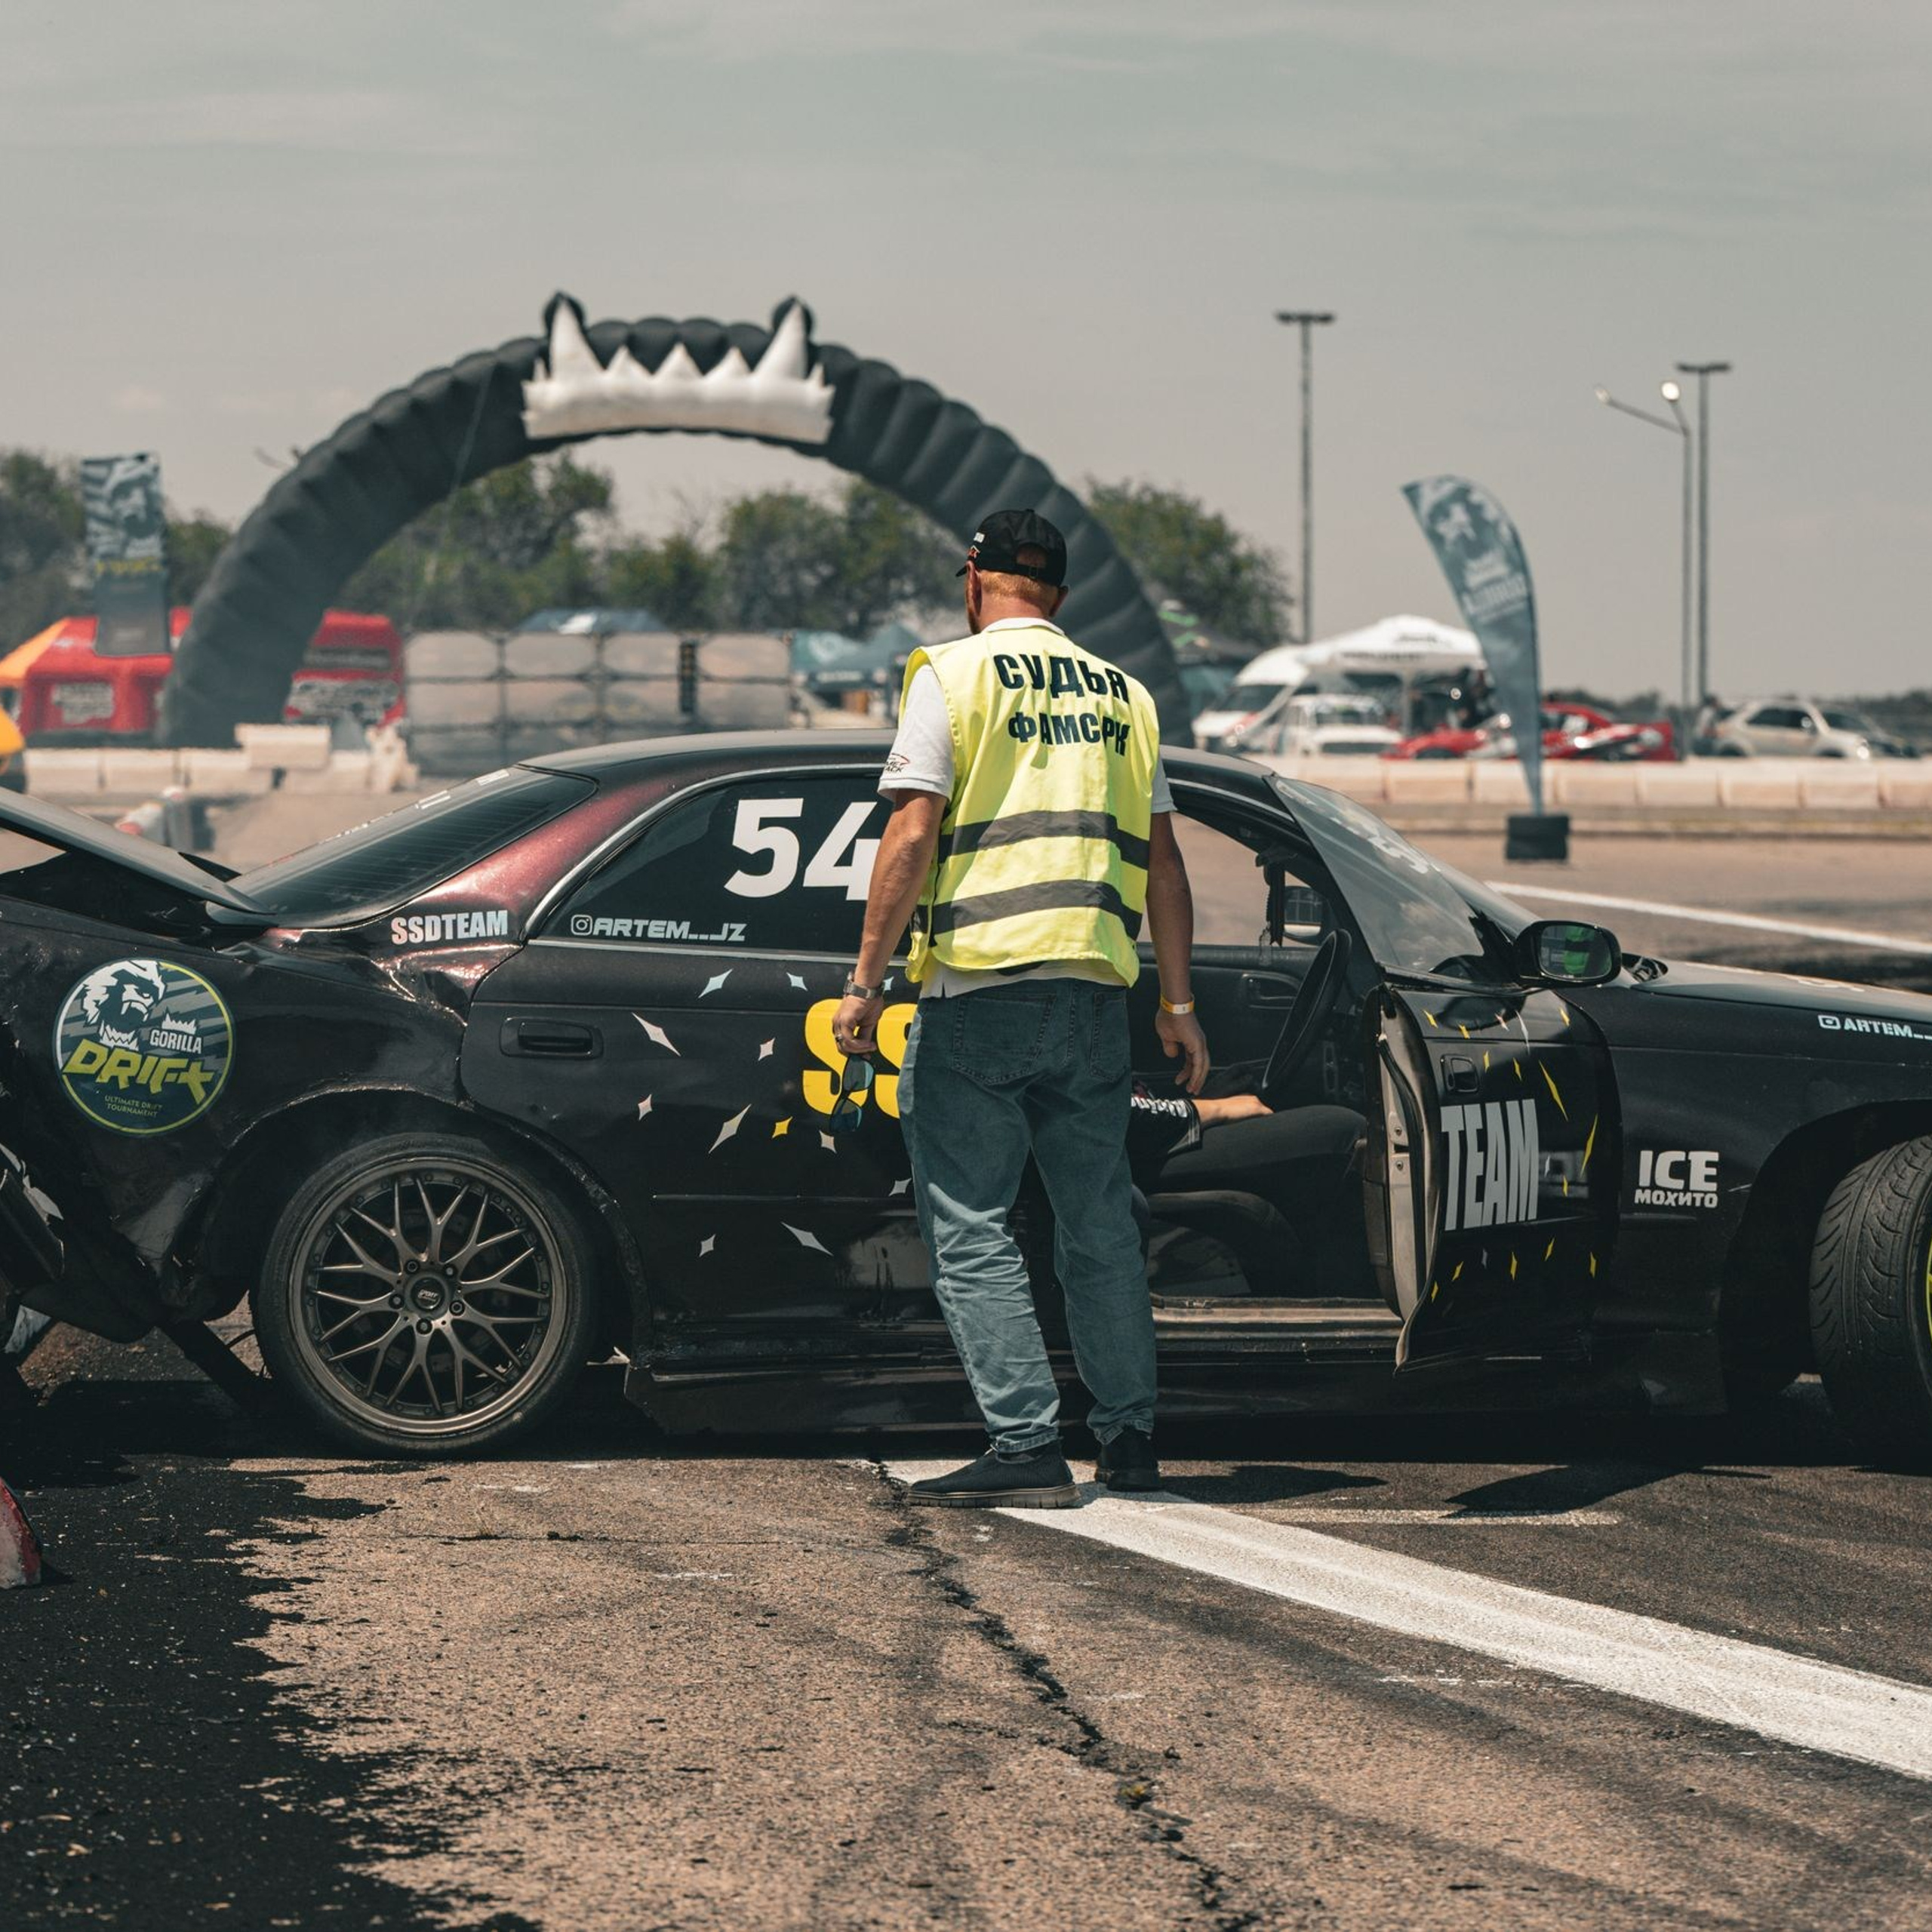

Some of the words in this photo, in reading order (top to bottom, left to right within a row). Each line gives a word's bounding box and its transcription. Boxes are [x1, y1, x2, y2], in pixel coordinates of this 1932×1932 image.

[993, 654, 1129, 705] СУДЬЯ
[724, 798, 881, 901] 54
[391, 910, 508, 945] SSDTEAM
[150, 1029, 202, 1054] GORILLA
[63, 1038, 215, 1105] DRIFT
[104, 1095, 140, 1108] ULTIMATE
[107, 1103, 158, 1117] TOURNAMENT
[1440, 1099, 1539, 1231] TEAM
[1638, 1150, 1719, 1192] ICE
[1634, 1189, 1718, 1208] МОХИТО
